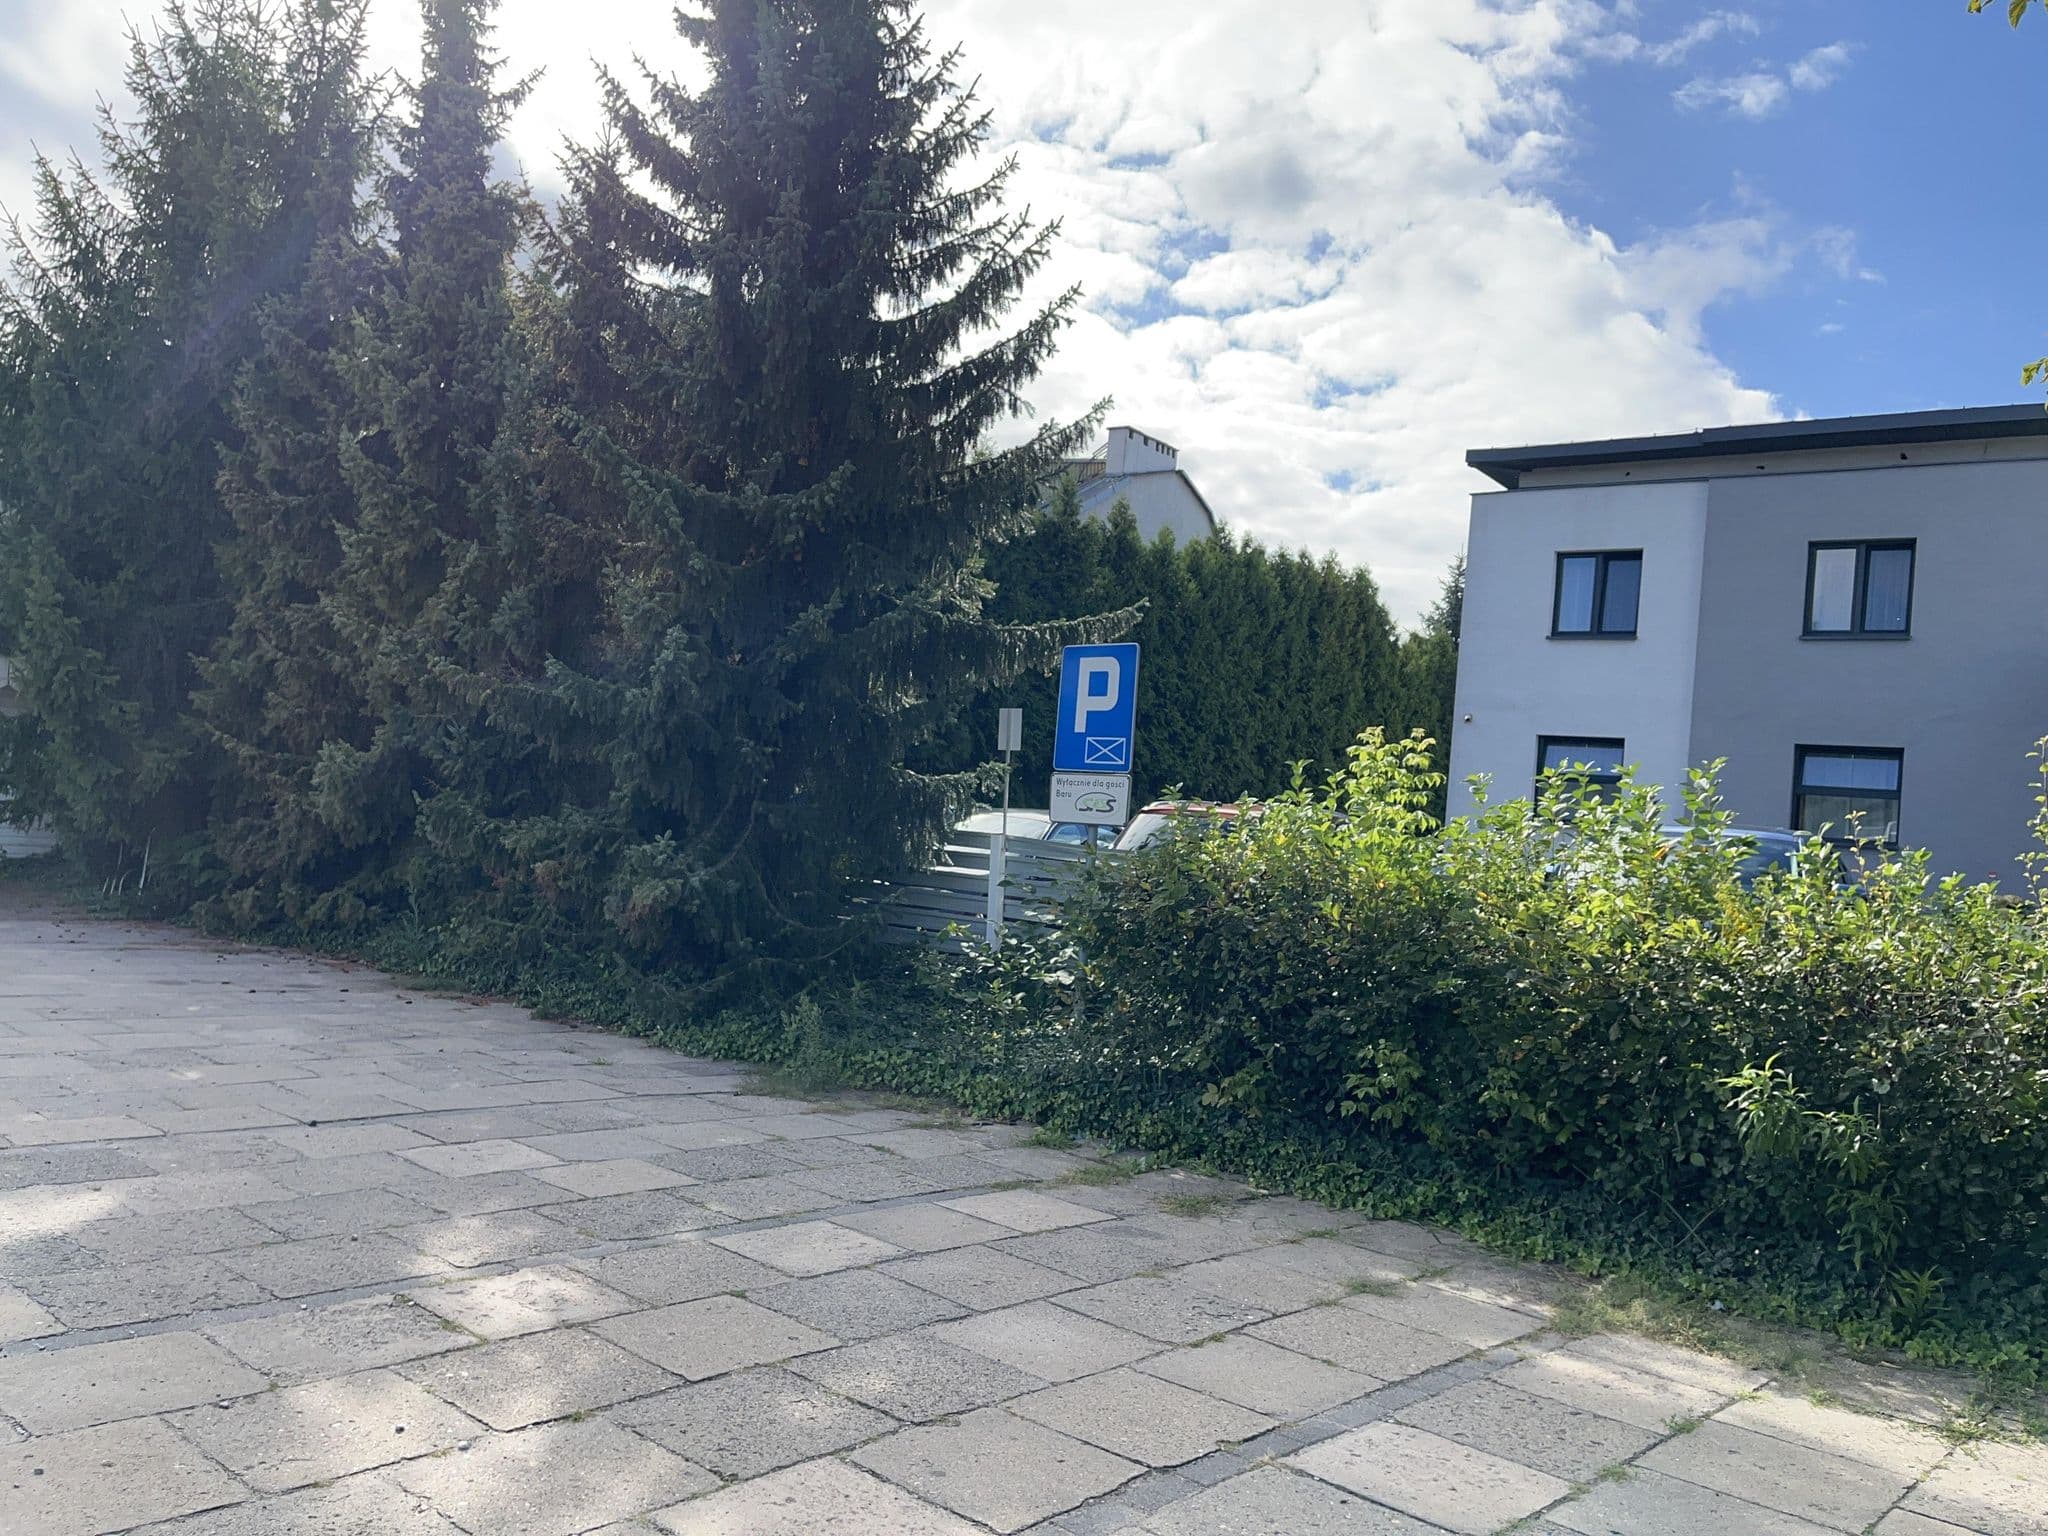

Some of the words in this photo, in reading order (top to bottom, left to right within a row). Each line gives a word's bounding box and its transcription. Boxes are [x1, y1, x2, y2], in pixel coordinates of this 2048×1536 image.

[1074, 656, 1120, 733] P
[1092, 779, 1104, 788] dla
[1056, 789, 1072, 798] Baru
